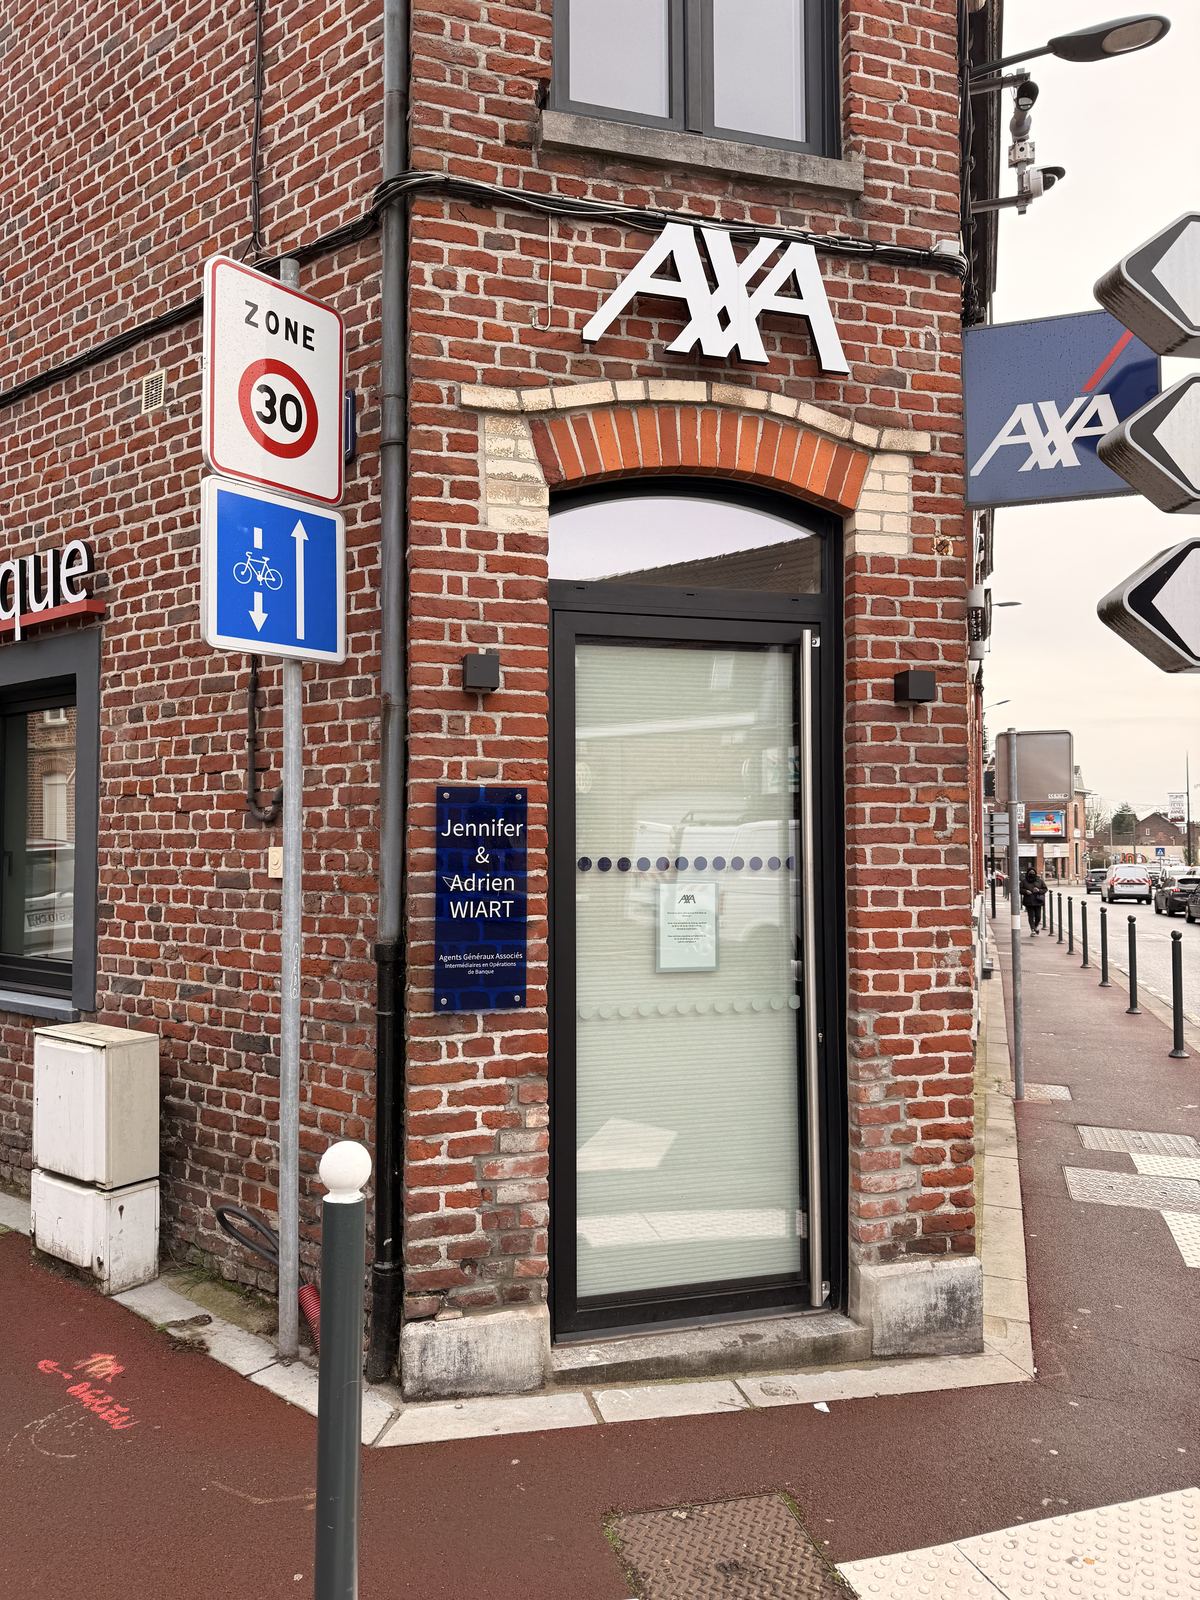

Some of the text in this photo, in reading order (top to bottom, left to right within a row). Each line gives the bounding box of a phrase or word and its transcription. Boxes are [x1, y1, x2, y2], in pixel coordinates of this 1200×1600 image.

[582, 222, 849, 375] AXA
[244, 300, 315, 352] ZONE
[256, 384, 303, 433] 30
[970, 394, 1120, 477] AXA
[0, 540, 88, 641] que
[441, 818, 524, 837] Jennifer
[475, 846, 490, 864] &
[449, 872, 515, 892] Adrien
[678, 894, 696, 904] AXA
[449, 900, 515, 919] WIART
[438, 951, 523, 963] Agents Généraux Associés
